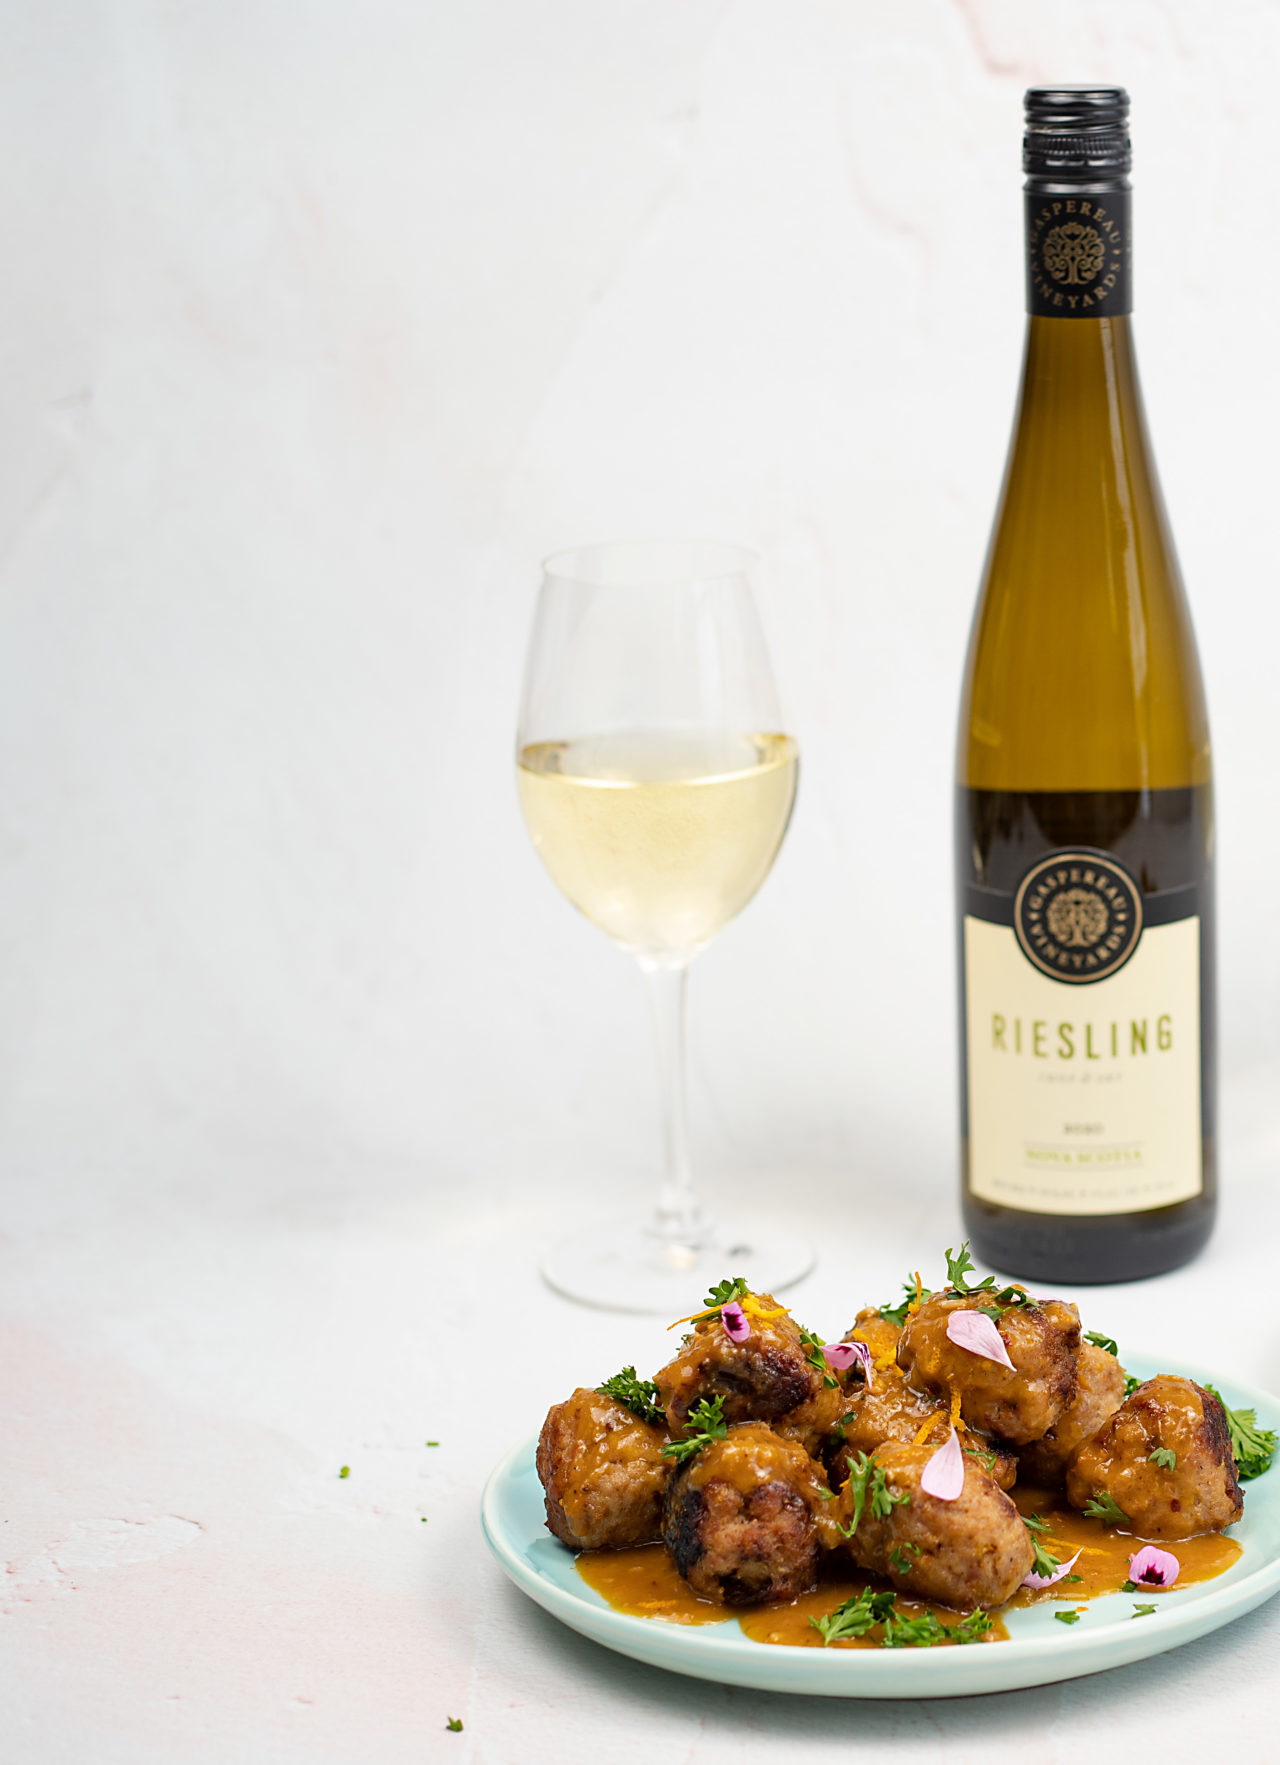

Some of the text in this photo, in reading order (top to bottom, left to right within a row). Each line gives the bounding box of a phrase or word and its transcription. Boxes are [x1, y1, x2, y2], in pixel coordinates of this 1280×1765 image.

[1028, 868, 1128, 910] GASPEREAU
[1030, 924, 1127, 968] VINEYARDS
[991, 1013, 1173, 1060] RIESLING
